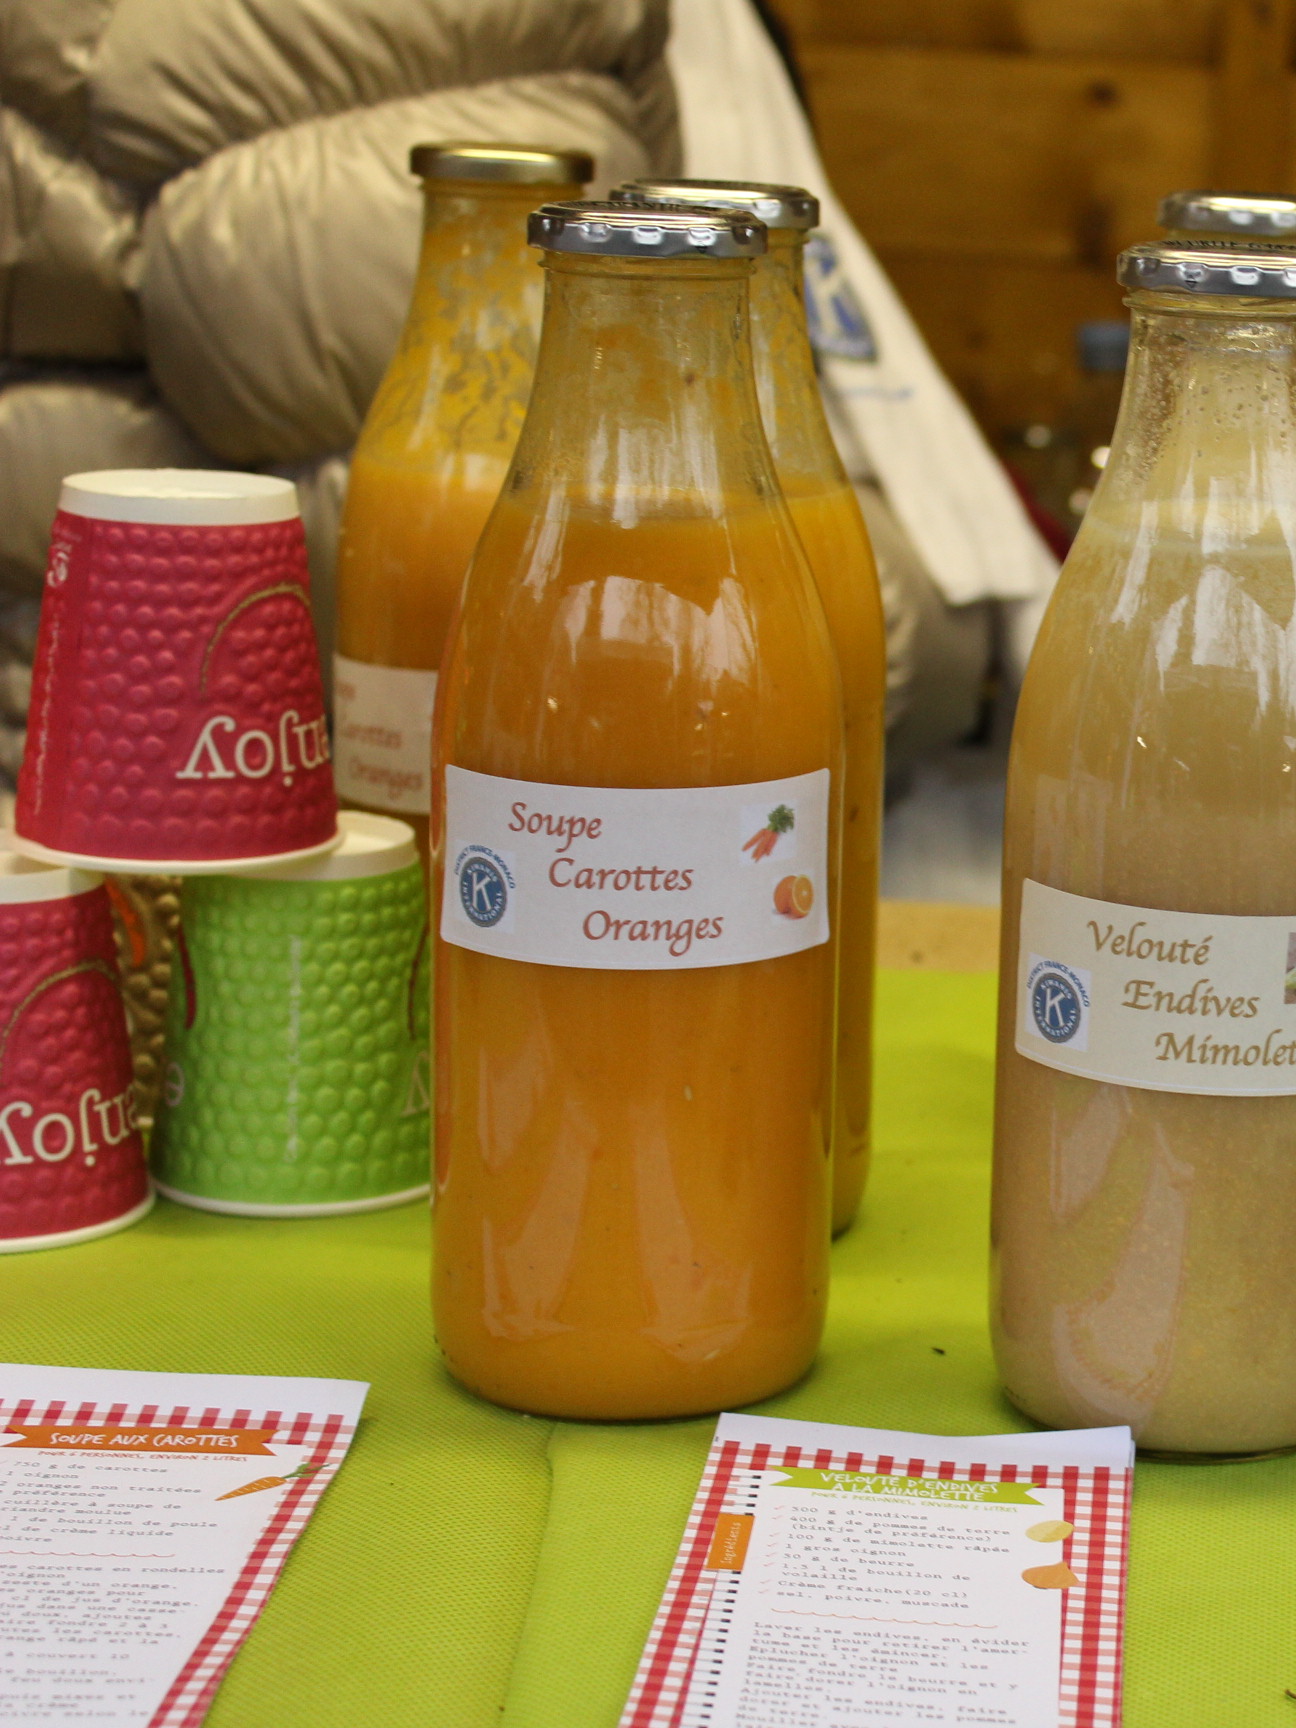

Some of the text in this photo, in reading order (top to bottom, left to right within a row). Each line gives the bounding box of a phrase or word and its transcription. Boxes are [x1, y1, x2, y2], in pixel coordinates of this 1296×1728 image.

[175, 709, 330, 787] njoy
[508, 801, 602, 853] Soupe
[549, 857, 694, 891] Carottes
[472, 871, 492, 912] K
[582, 909, 724, 956] Oranges
[1086, 920, 1213, 966] Velouté
[1122, 979, 1260, 1018] Endives
[1044, 987, 1066, 1027] K
[50, 1432, 239, 1448] SOUPE AUX CAROTTES
[24, 1471, 79, 1479] oignon
[95, 1464, 168, 1473] carottes
[17, 1482, 82, 1490] oranges
[853, 1483, 873, 1494] LA
[880, 1485, 985, 1501] MIMOLETTE
[907, 1477, 998, 1494] D'ENDIVES
[75, 1508, 132, 1516] moulue
[57, 1517, 132, 1526] bouillon
[170, 1520, 218, 1529] poule
[845, 1518, 863, 1526] de
[873, 1521, 927, 1530] pommes
[937, 1525, 955, 1533] de
[864, 1527, 882, 1535] de
[842, 1536, 861, 1544] de
[830, 1555, 849, 1564] de
[859, 1557, 915, 1567] beurre
[0, 1571, 65, 1579] 'oignon
[141, 1566, 226, 1574] rondelles
